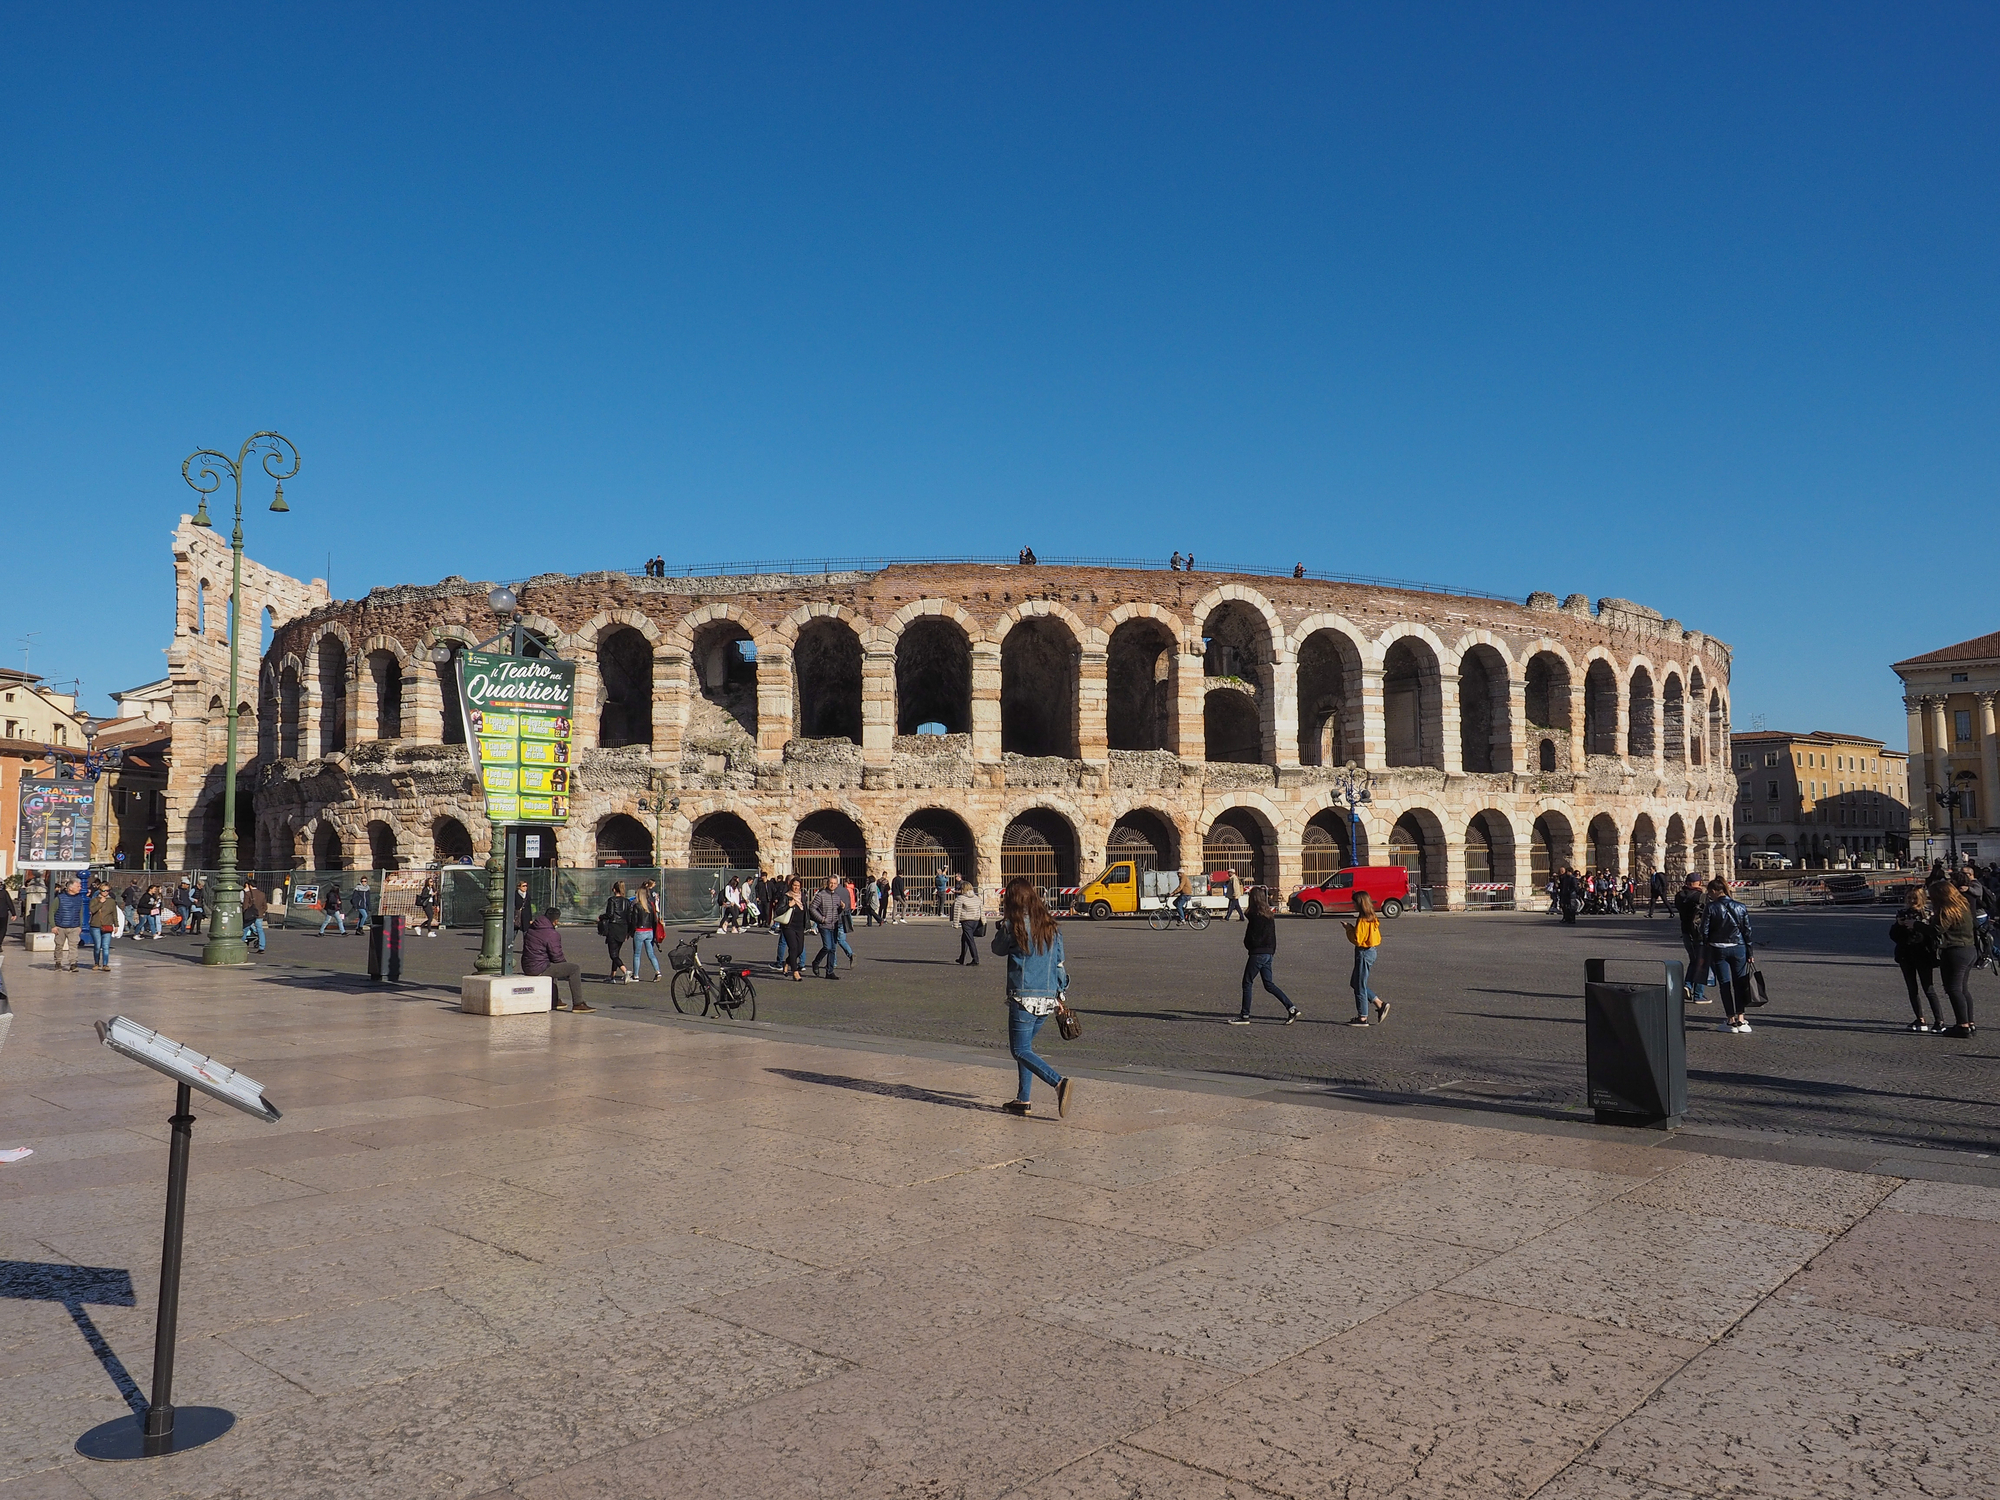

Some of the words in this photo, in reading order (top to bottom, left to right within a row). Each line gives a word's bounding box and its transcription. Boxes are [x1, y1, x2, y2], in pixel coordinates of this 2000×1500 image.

[490, 668, 499, 677] Il
[499, 662, 552, 681] Teatro
[467, 674, 571, 705] Quartieri
[37, 787, 80, 795] GRANDE
[42, 794, 93, 803] TEATRO
